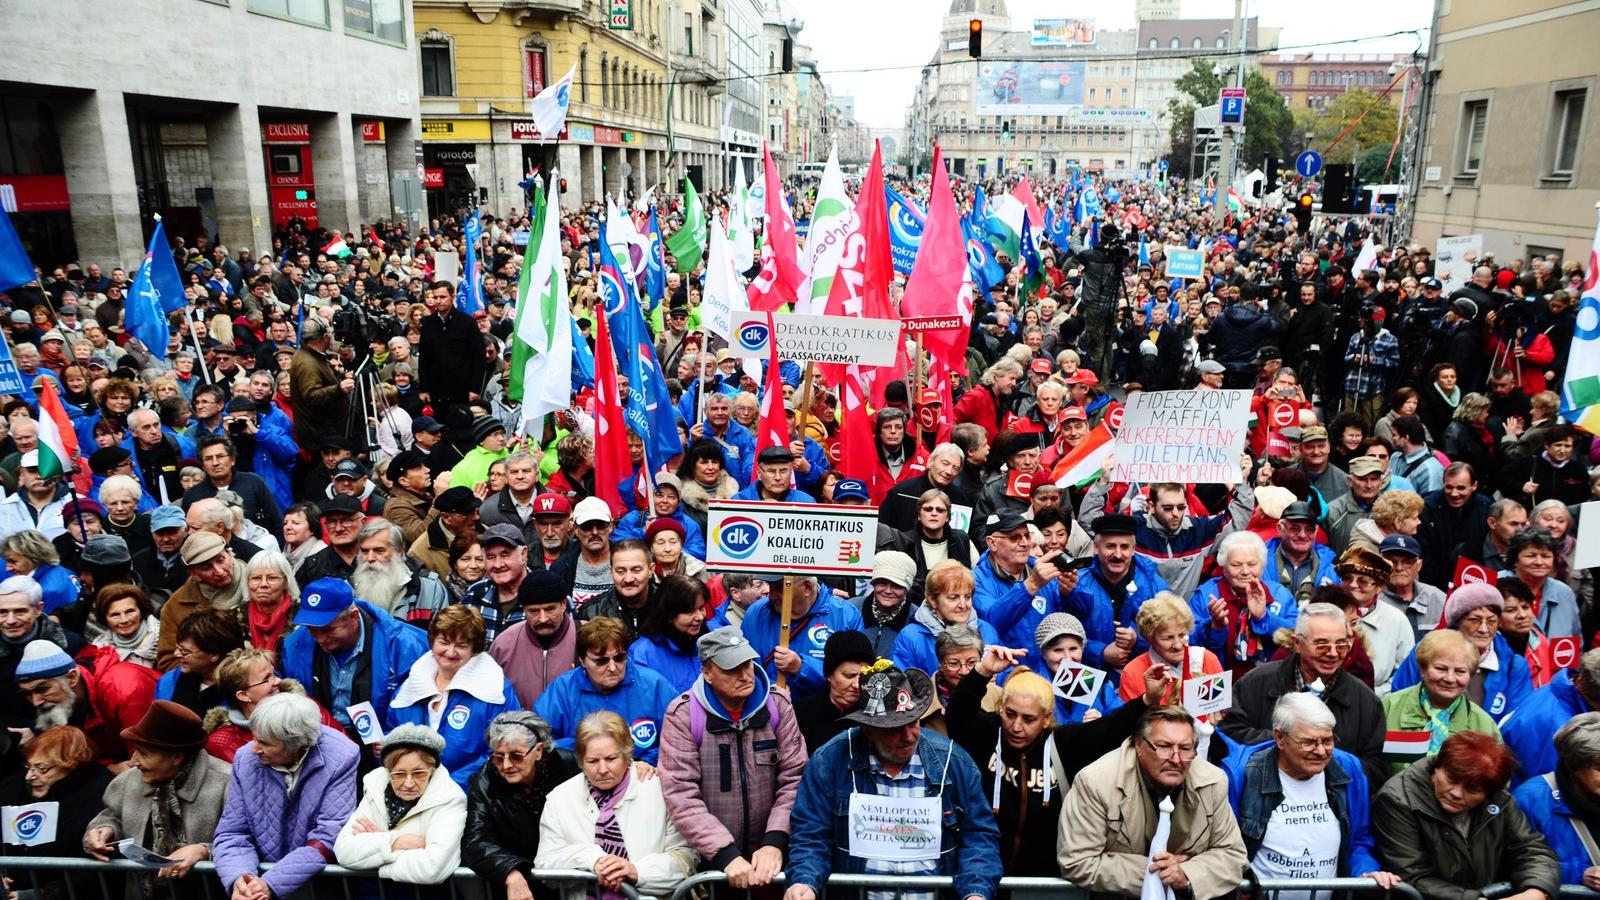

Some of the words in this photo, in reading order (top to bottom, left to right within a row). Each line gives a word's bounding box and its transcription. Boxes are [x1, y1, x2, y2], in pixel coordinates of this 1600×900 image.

[269, 123, 309, 136] EXCLUSIVE
[745, 329, 761, 341] dk
[776, 322, 895, 342] DEMOKRATIKUS
[908, 320, 960, 332] Dunakeszi
[776, 338, 848, 353] KOALÍCIÓ
[1137, 391, 1197, 409] FIDESZ
[1200, 390, 1242, 409] KDNP
[1150, 408, 1221, 428] MAFFIA
[541, 498, 555, 511] W
[727, 528, 749, 545] dk
[768, 517, 864, 534] DEMOKRATIKUS
[767, 535, 824, 553] KOALÍCIÓ
[773, 553, 816, 565] DÉL-BUDA
[636, 725, 652, 738] dk
[861, 804, 882, 814] NEM
[20, 818, 36, 831] dk
[1312, 813, 1329, 823] fél.
[1302, 848, 1311, 857] A
[1267, 853, 1316, 868] többinek
[1289, 869, 1320, 879] Tilos!
